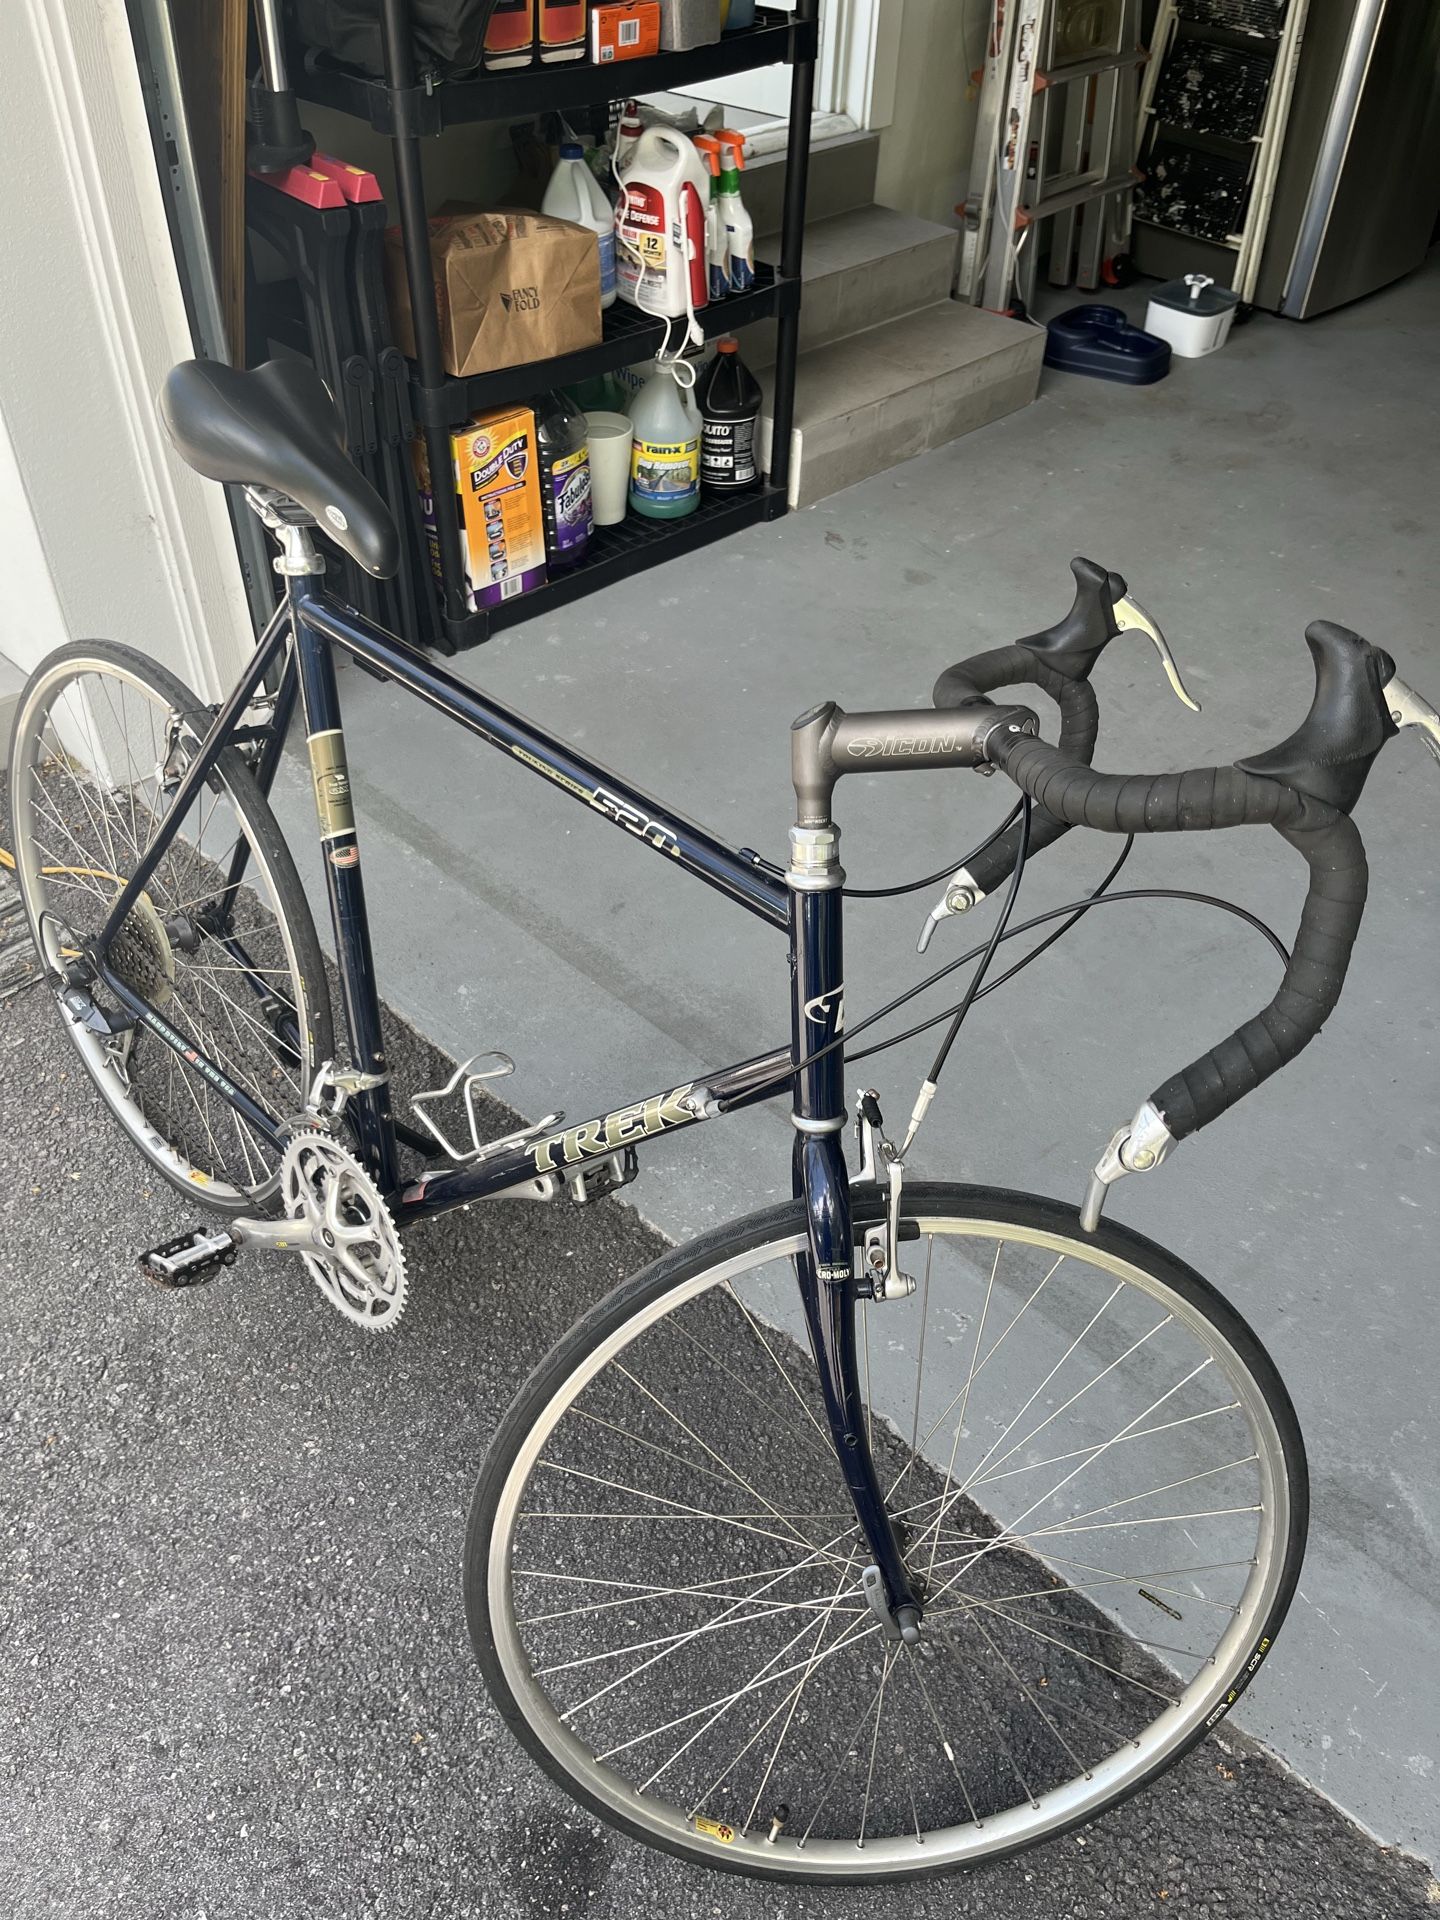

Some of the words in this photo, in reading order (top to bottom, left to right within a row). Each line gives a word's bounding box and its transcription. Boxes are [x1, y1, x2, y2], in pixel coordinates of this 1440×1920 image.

[646, 237, 658, 250] 12
[512, 286, 538, 300] FANCY
[514, 297, 541, 312] FOLD
[474, 455, 504, 482] DOUBLE
[503, 438, 524, 459] DUTY
[590, 786, 680, 857] 520
[524, 1082, 696, 1173] TREK
